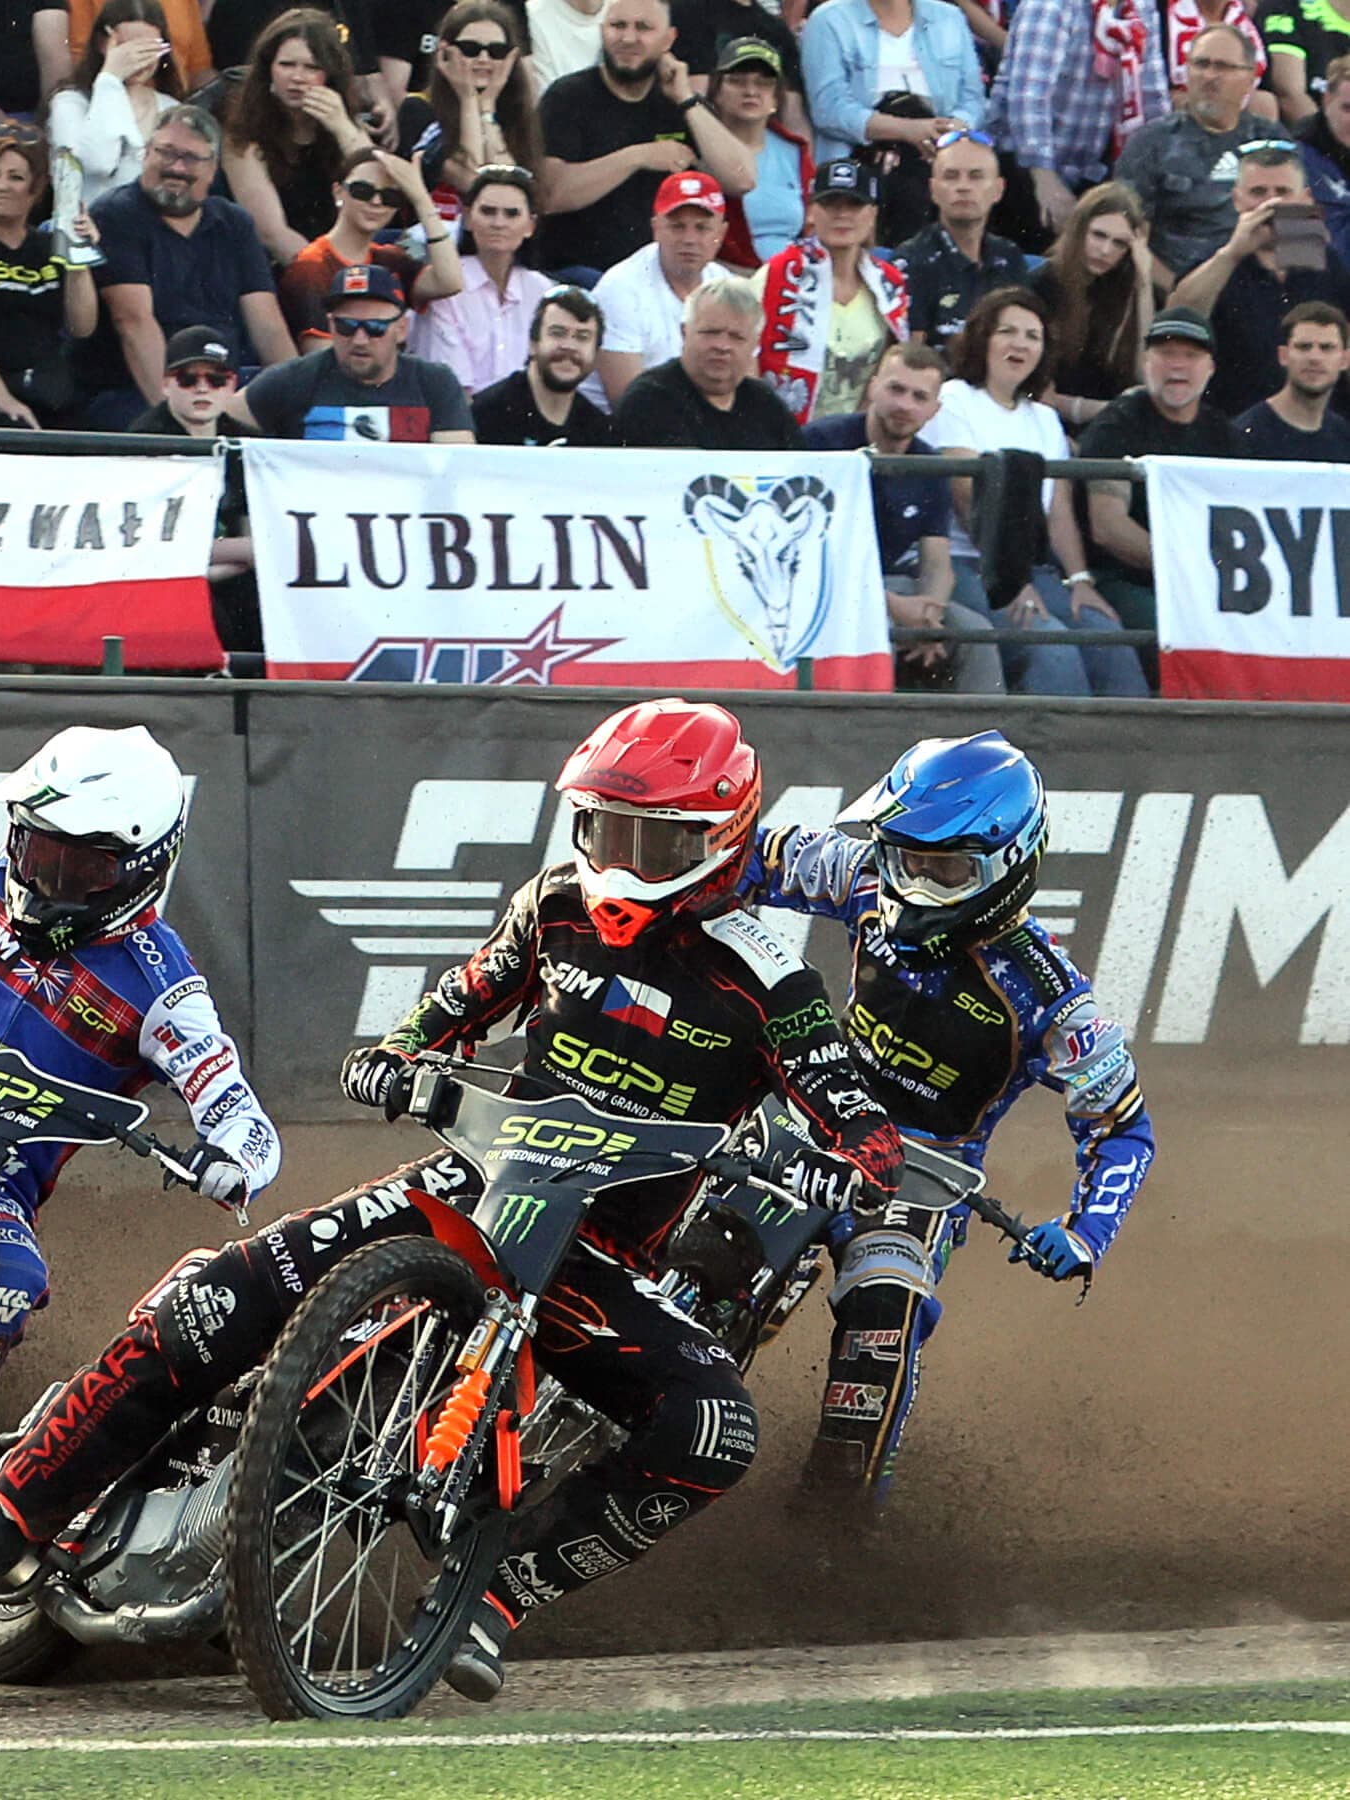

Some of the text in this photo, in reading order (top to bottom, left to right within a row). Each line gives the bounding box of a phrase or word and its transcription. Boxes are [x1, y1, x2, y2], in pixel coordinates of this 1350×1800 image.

[285, 509, 650, 591] LUBLIN
[553, 961, 605, 1001] FIM
[66, 994, 119, 1035] SGP
[952, 991, 1005, 1025] SGP
[667, 1019, 733, 1051] SGP
[547, 1031, 665, 1094] SGP
[610, 1095, 649, 1119] GRAND
[913, 1081, 942, 1102] PRIX
[13, 1113, 41, 1130] PRIX
[492, 1114, 608, 1152] SGP
[500, 1149, 552, 1168] SPEEDWAY
[584, 1161, 613, 1177] PRIX
[266, 1230, 304, 1293] OLYMP
[181, 1303, 214, 1365] TRANS
[860, 1331, 901, 1345] SPORT
[39, 1373, 139, 1482] Automation
[206, 1405, 244, 1429] OLYMP
